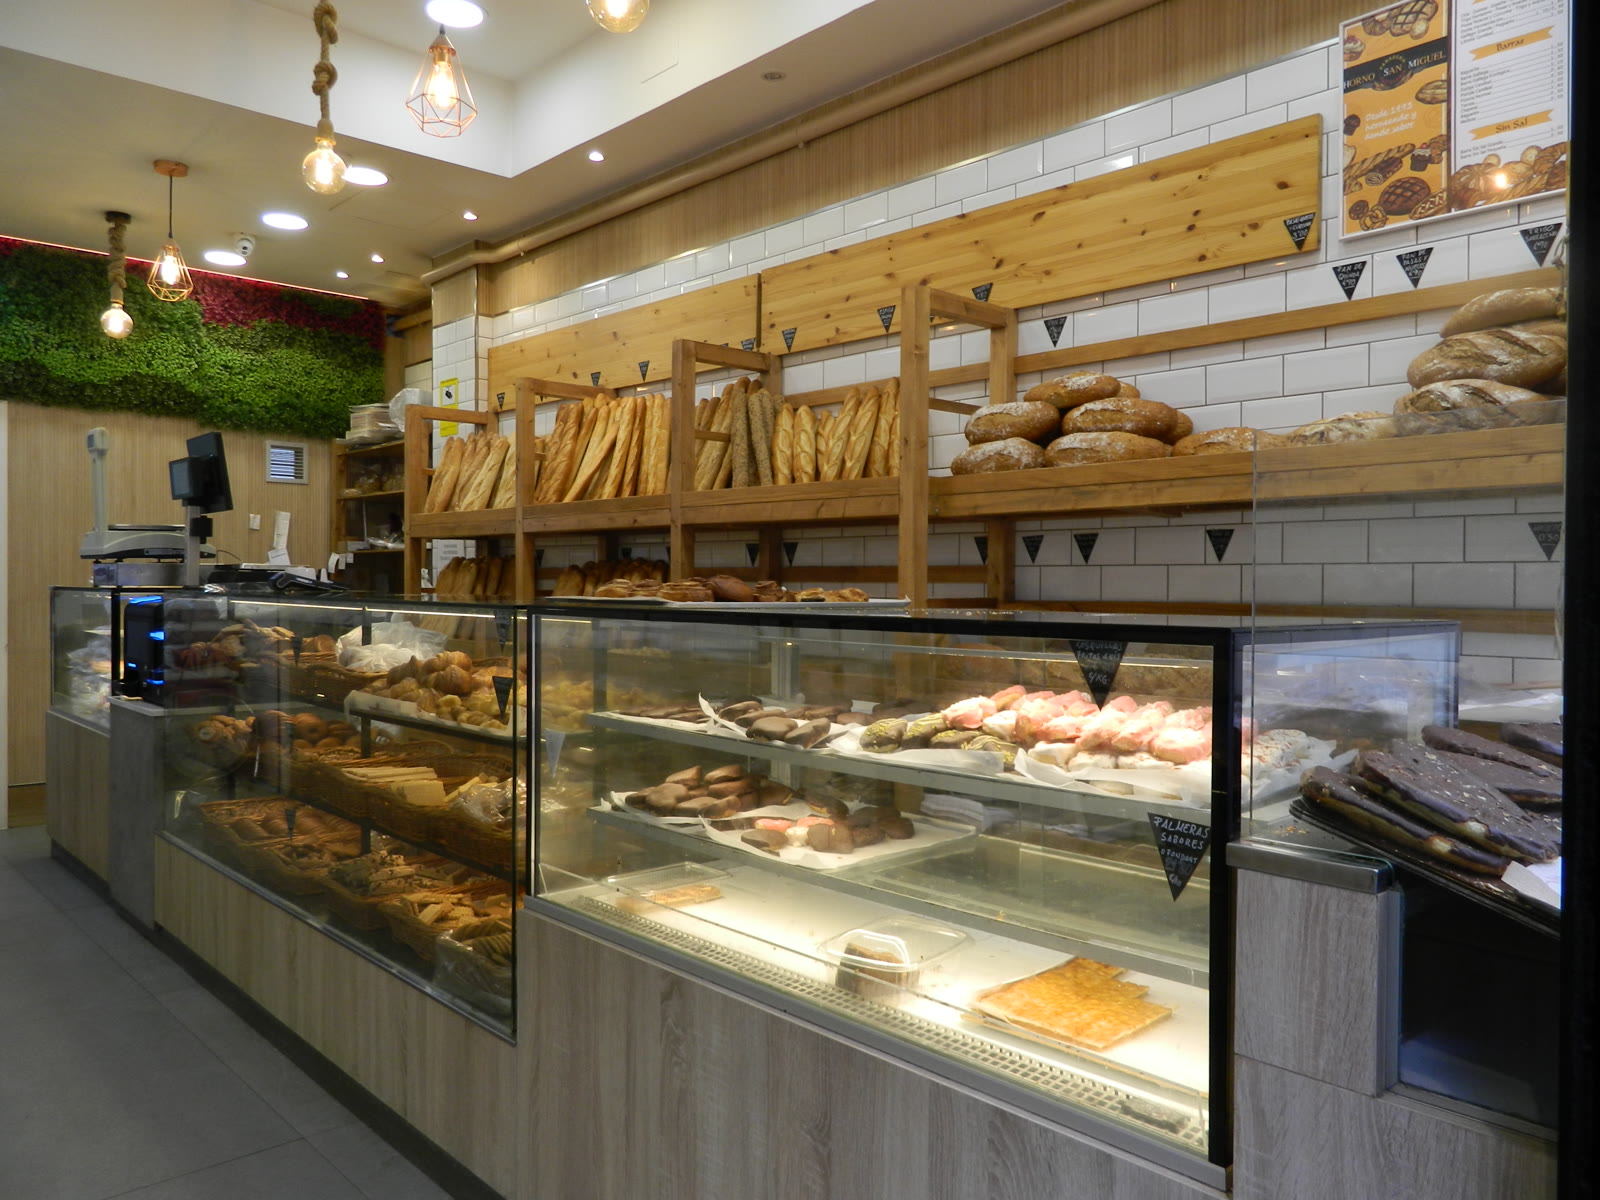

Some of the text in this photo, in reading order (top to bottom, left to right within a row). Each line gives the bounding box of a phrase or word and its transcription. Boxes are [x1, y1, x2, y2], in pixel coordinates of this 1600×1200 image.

[1496, 38, 1525, 52] Barras
[1343, 72, 1376, 89] HORNO
[1383, 64, 1403, 77] SAN
[1408, 51, 1447, 69] MIGUEL
[1496, 117, 1528, 134] Sin Sal
[1337, 262, 1364, 273] PAN DE
[1153, 815, 1210, 839] PALMERAS
[1161, 832, 1205, 850] SABORES
